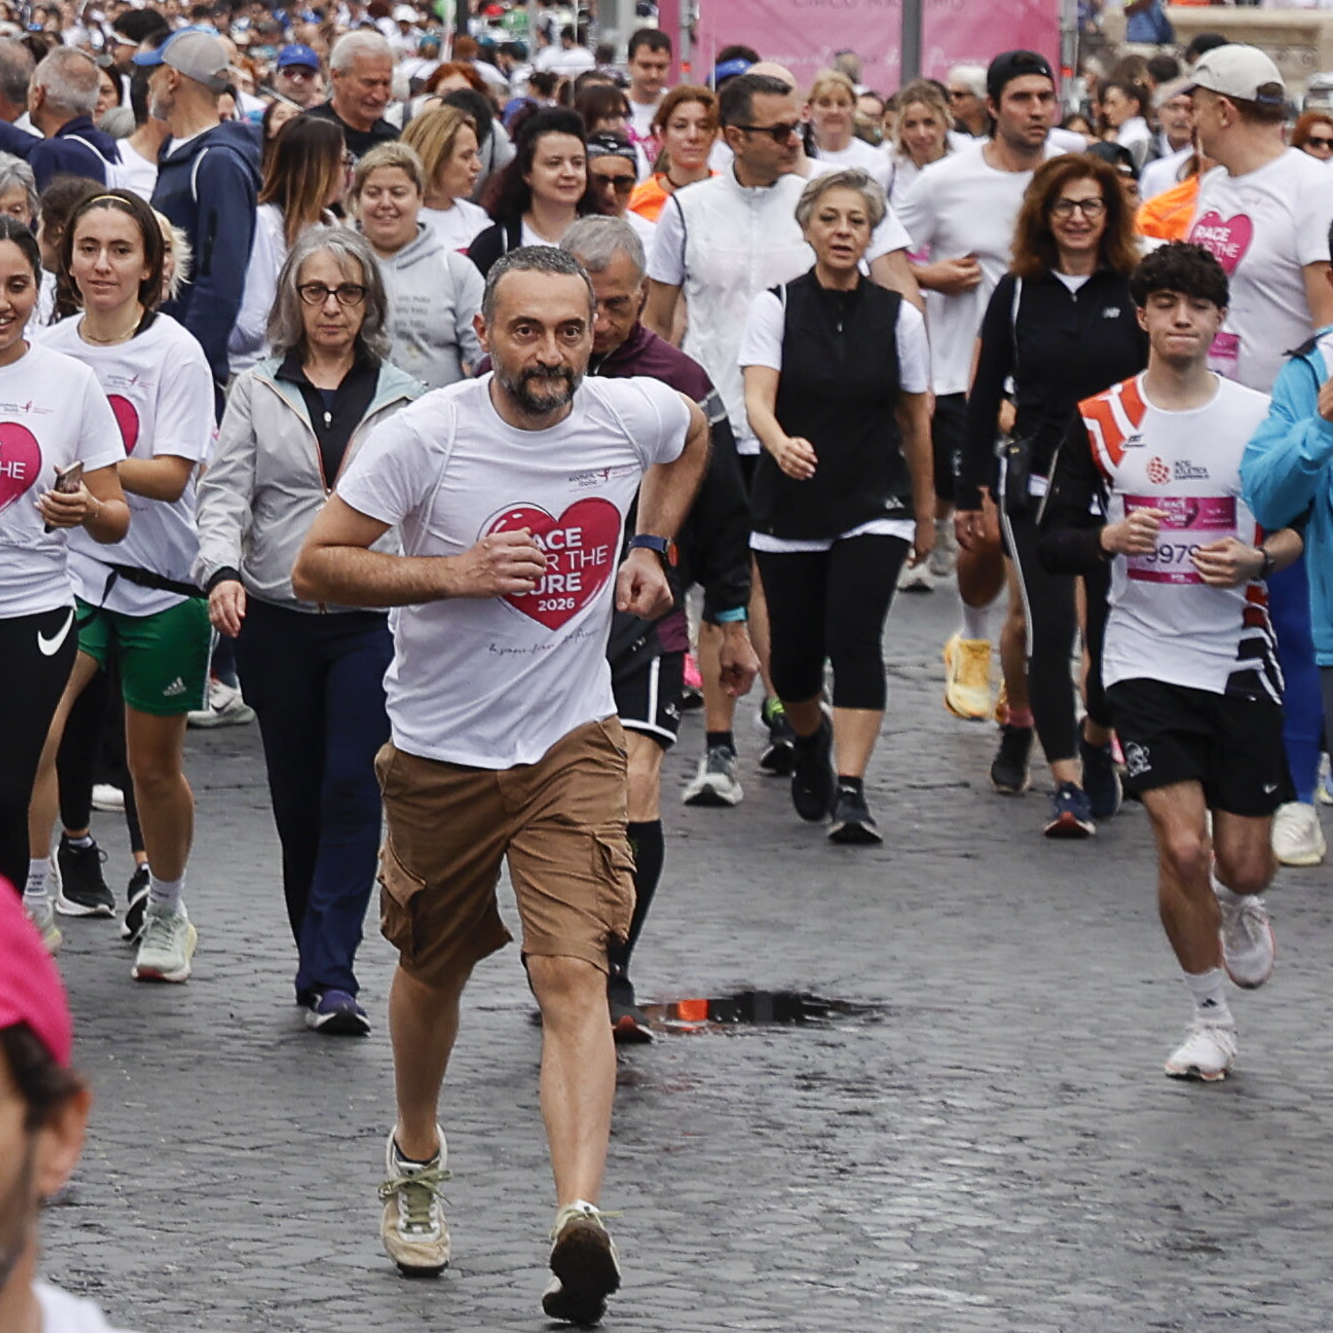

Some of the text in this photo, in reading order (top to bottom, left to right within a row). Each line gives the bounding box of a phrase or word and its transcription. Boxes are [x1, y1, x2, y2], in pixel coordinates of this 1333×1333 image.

[534, 527, 583, 551] ACE
[565, 544, 609, 568] THE
[537, 597, 576, 612] 2026
